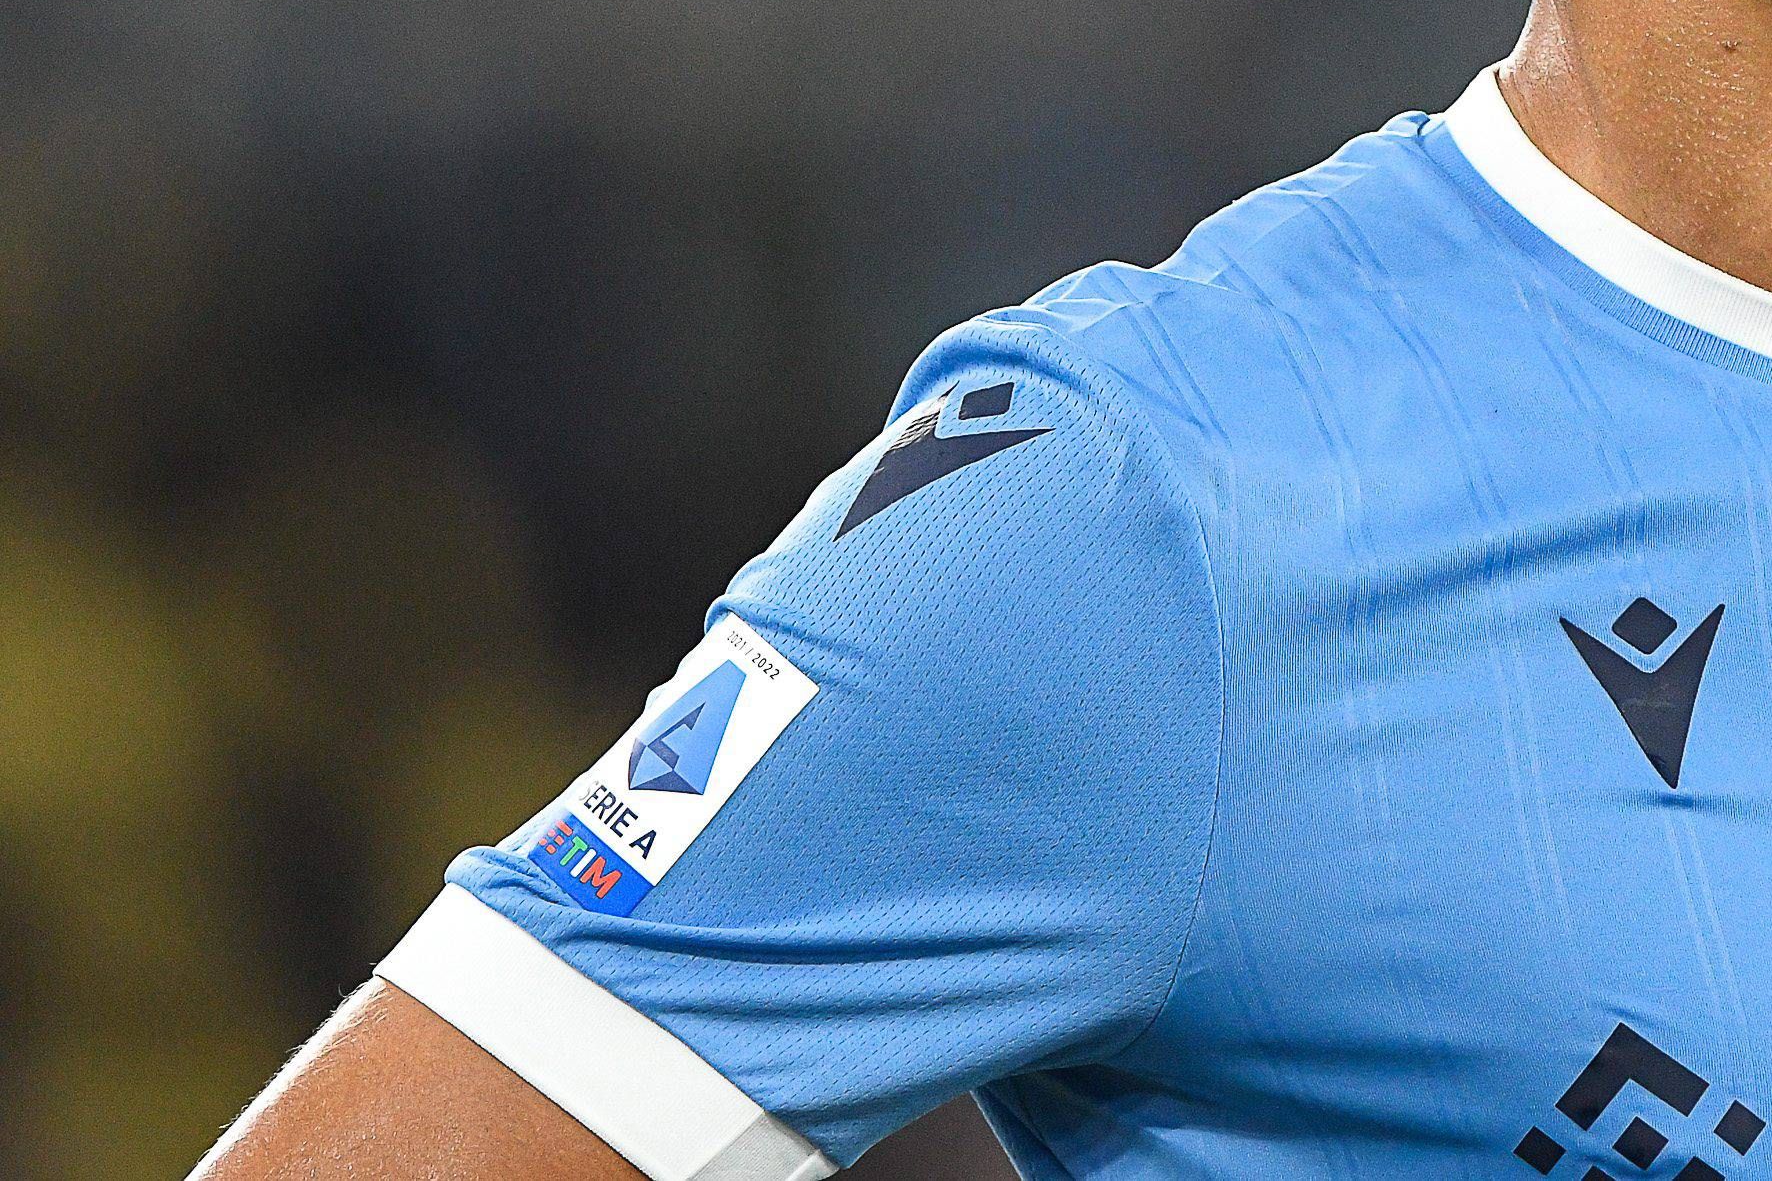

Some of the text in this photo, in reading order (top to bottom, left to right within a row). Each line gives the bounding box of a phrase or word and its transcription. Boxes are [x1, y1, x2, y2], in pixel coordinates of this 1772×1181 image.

[751, 652, 780, 680] 2022
[628, 829, 657, 860] A
[559, 835, 623, 899] TIM
